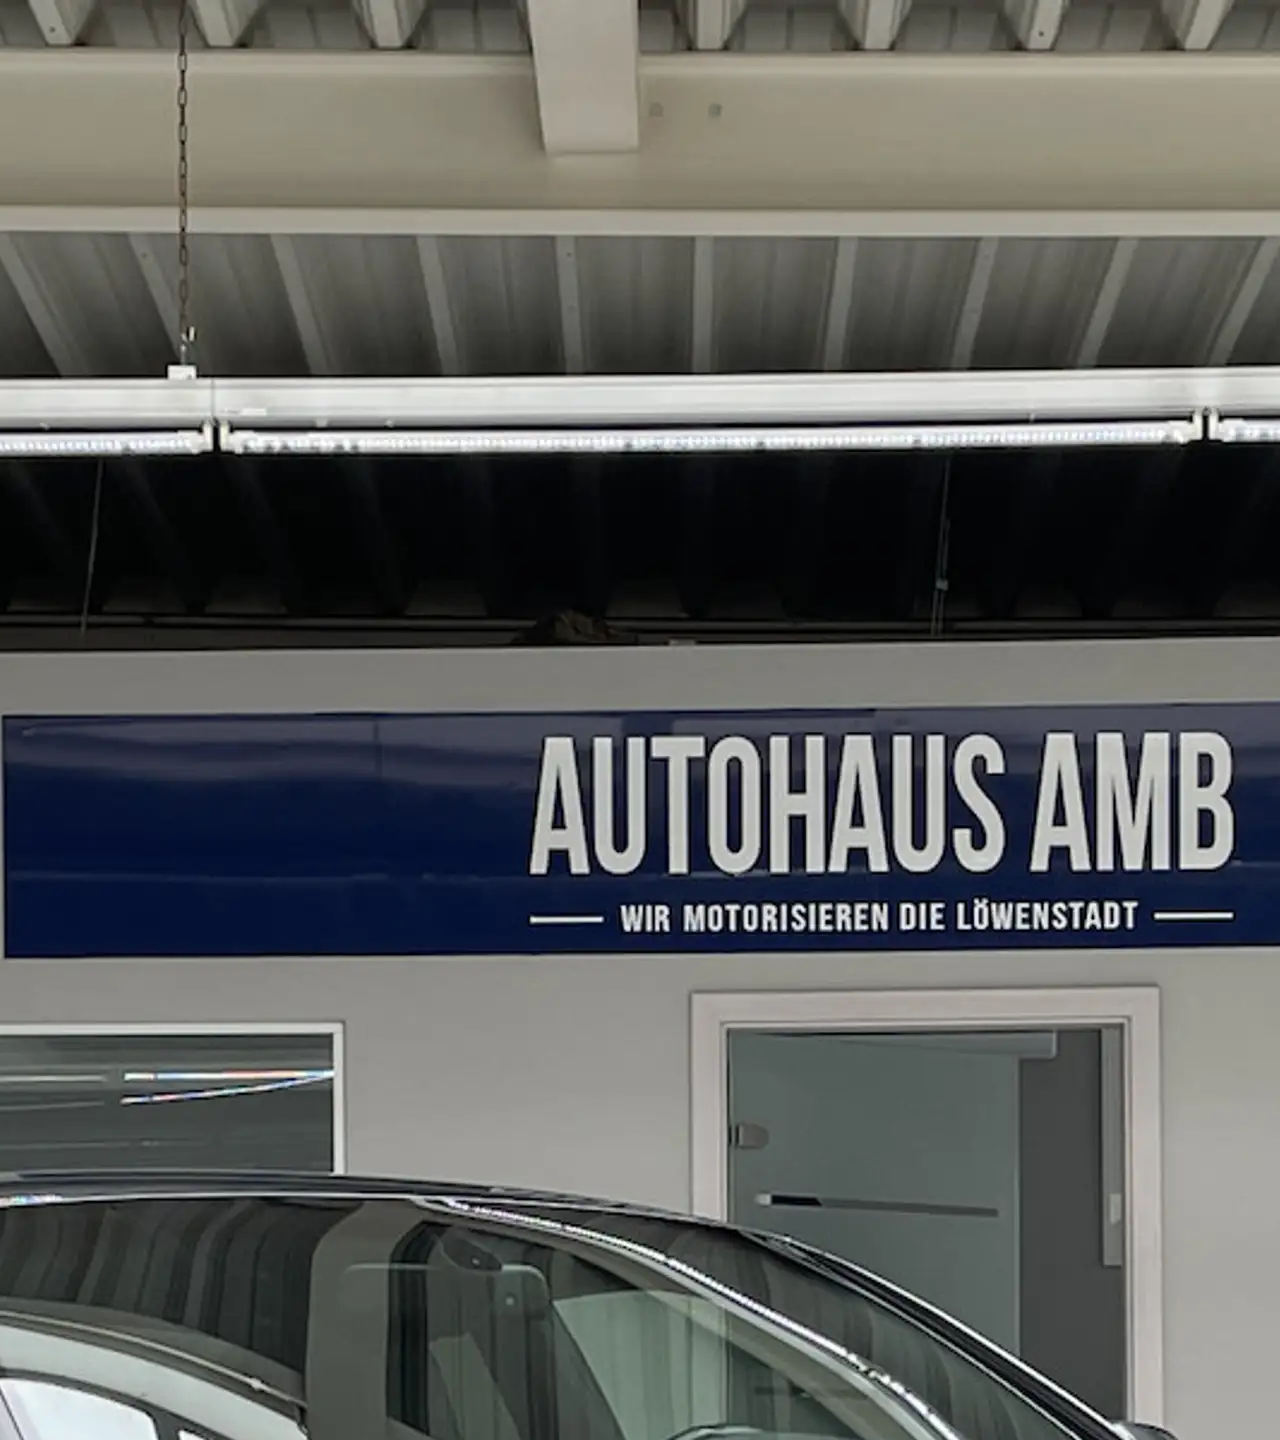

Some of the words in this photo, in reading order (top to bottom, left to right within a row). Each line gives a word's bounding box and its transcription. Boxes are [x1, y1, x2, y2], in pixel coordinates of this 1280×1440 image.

[529, 734, 1007, 876] AUTOHAUS
[1029, 731, 1235, 873] AMB
[620, 904, 671, 932] WIR
[683, 902, 889, 932] MOTORISIEREN
[899, 902, 946, 931] DIE
[956, 897, 1139, 931] LÖWENSTADT
